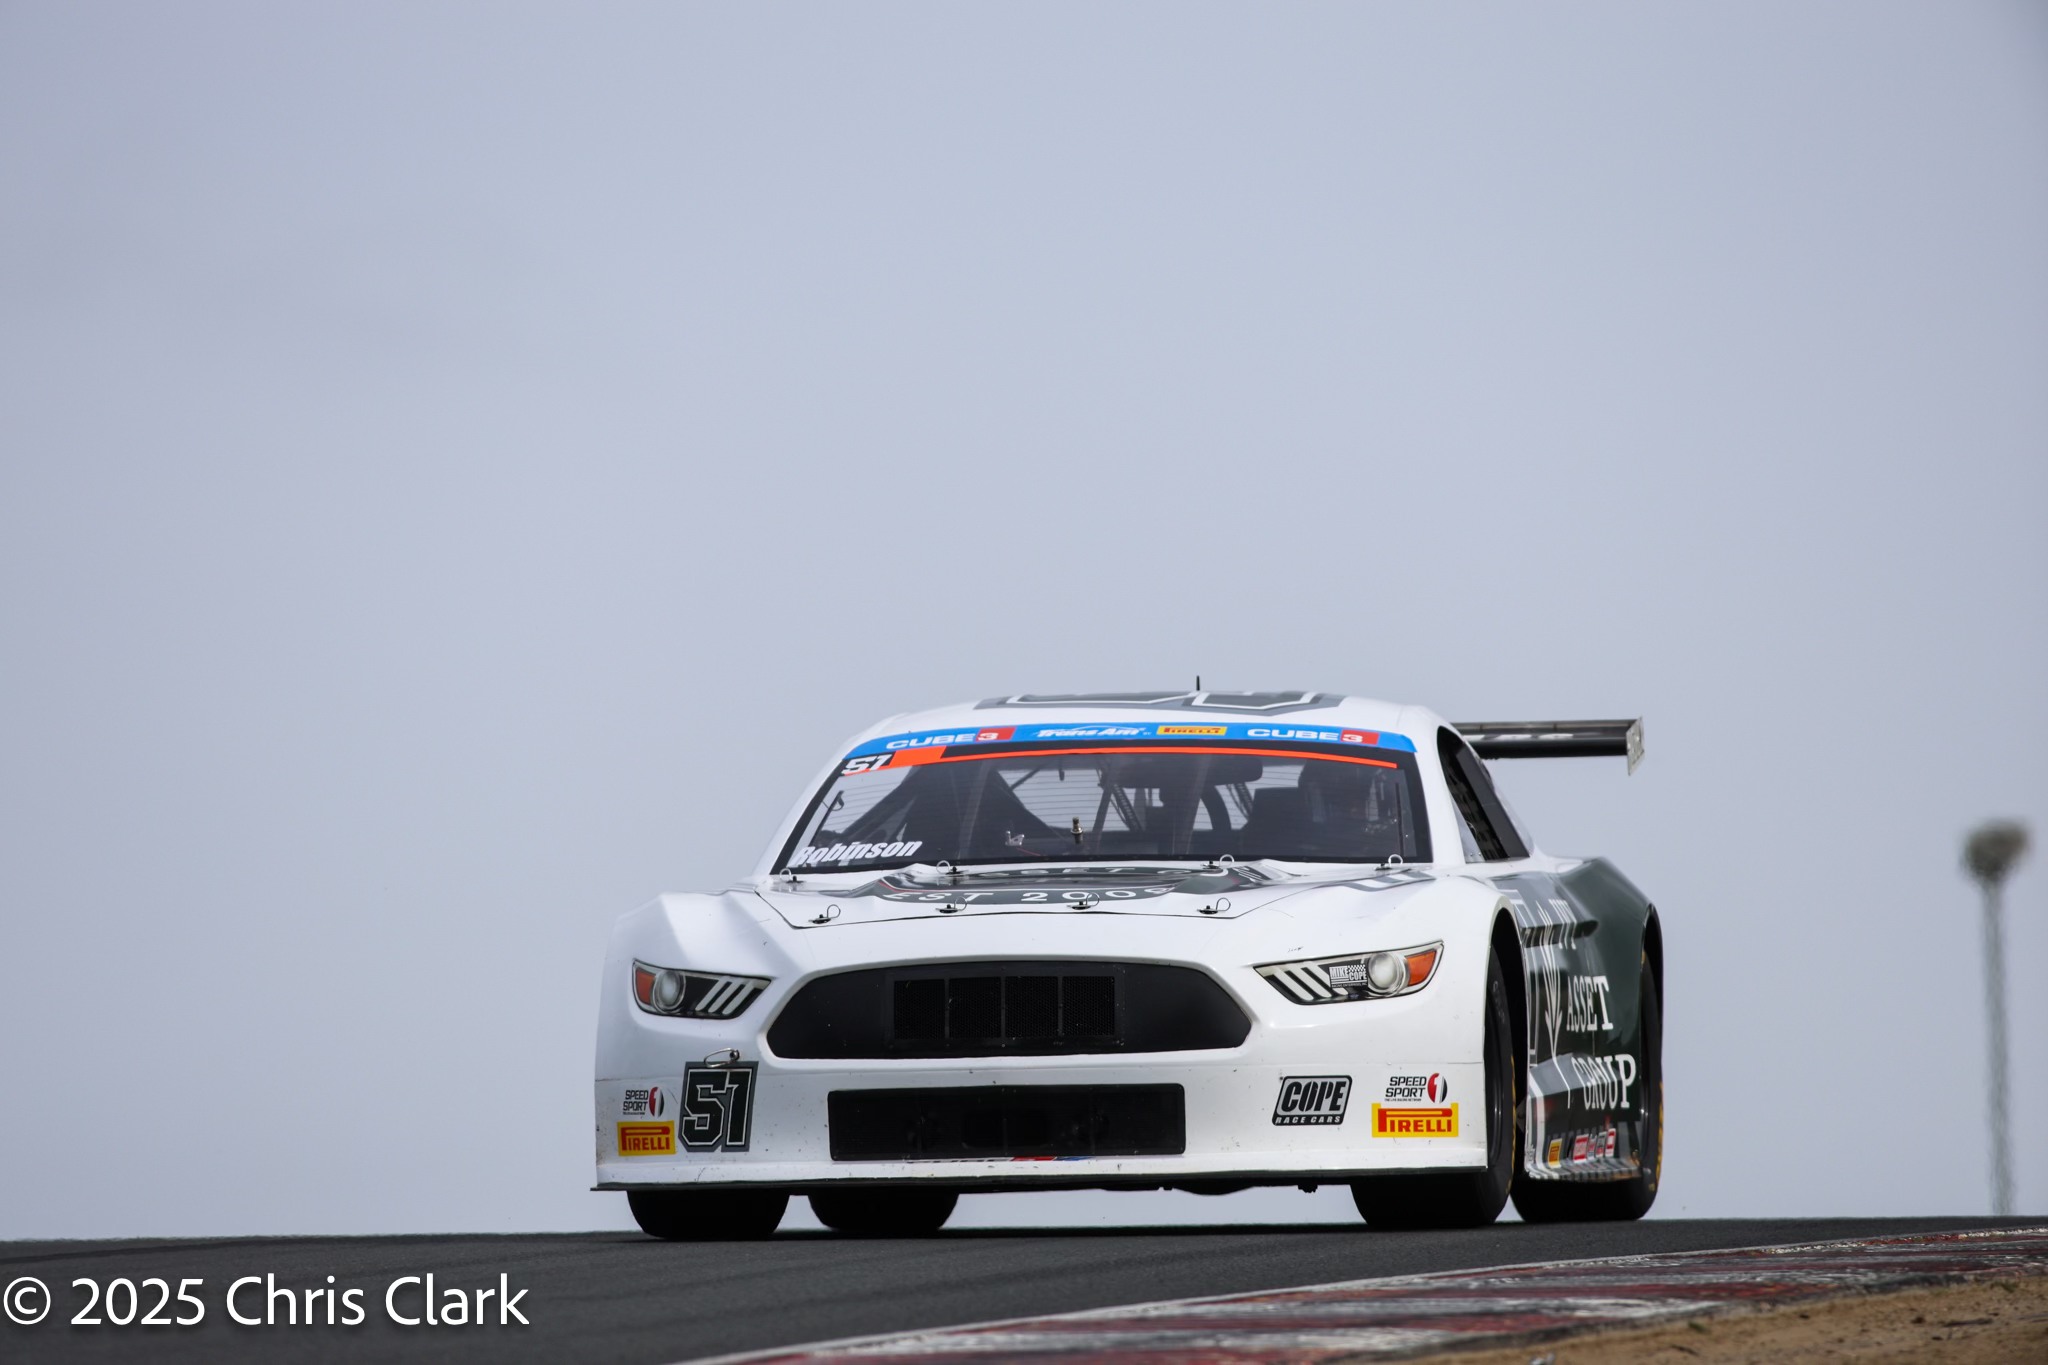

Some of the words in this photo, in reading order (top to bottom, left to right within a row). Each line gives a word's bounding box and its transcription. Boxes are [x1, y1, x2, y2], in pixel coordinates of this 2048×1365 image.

[1163, 727, 1222, 735] PIRELLI
[841, 753, 893, 775] 51
[787, 840, 923, 868] Robinson
[882, 891, 994, 902] EST
[1329, 966, 1348, 978] MIKE
[1348, 971, 1367, 981] COPE
[1566, 975, 1614, 1032] ASSET
[1389, 1076, 1427, 1087] SPEED
[625, 1090, 649, 1100] SPEED
[1281, 1080, 1347, 1112] COPE
[1385, 1087, 1426, 1098] SPORT
[622, 1101, 648, 1112] SPORT
[682, 1068, 752, 1146] 51
[1275, 1116, 1306, 1124] RACE
[1311, 1116, 1341, 1124] CARS
[1377, 1107, 1453, 1132] PIRELLI
[620, 1126, 671, 1151] PIRELLI
